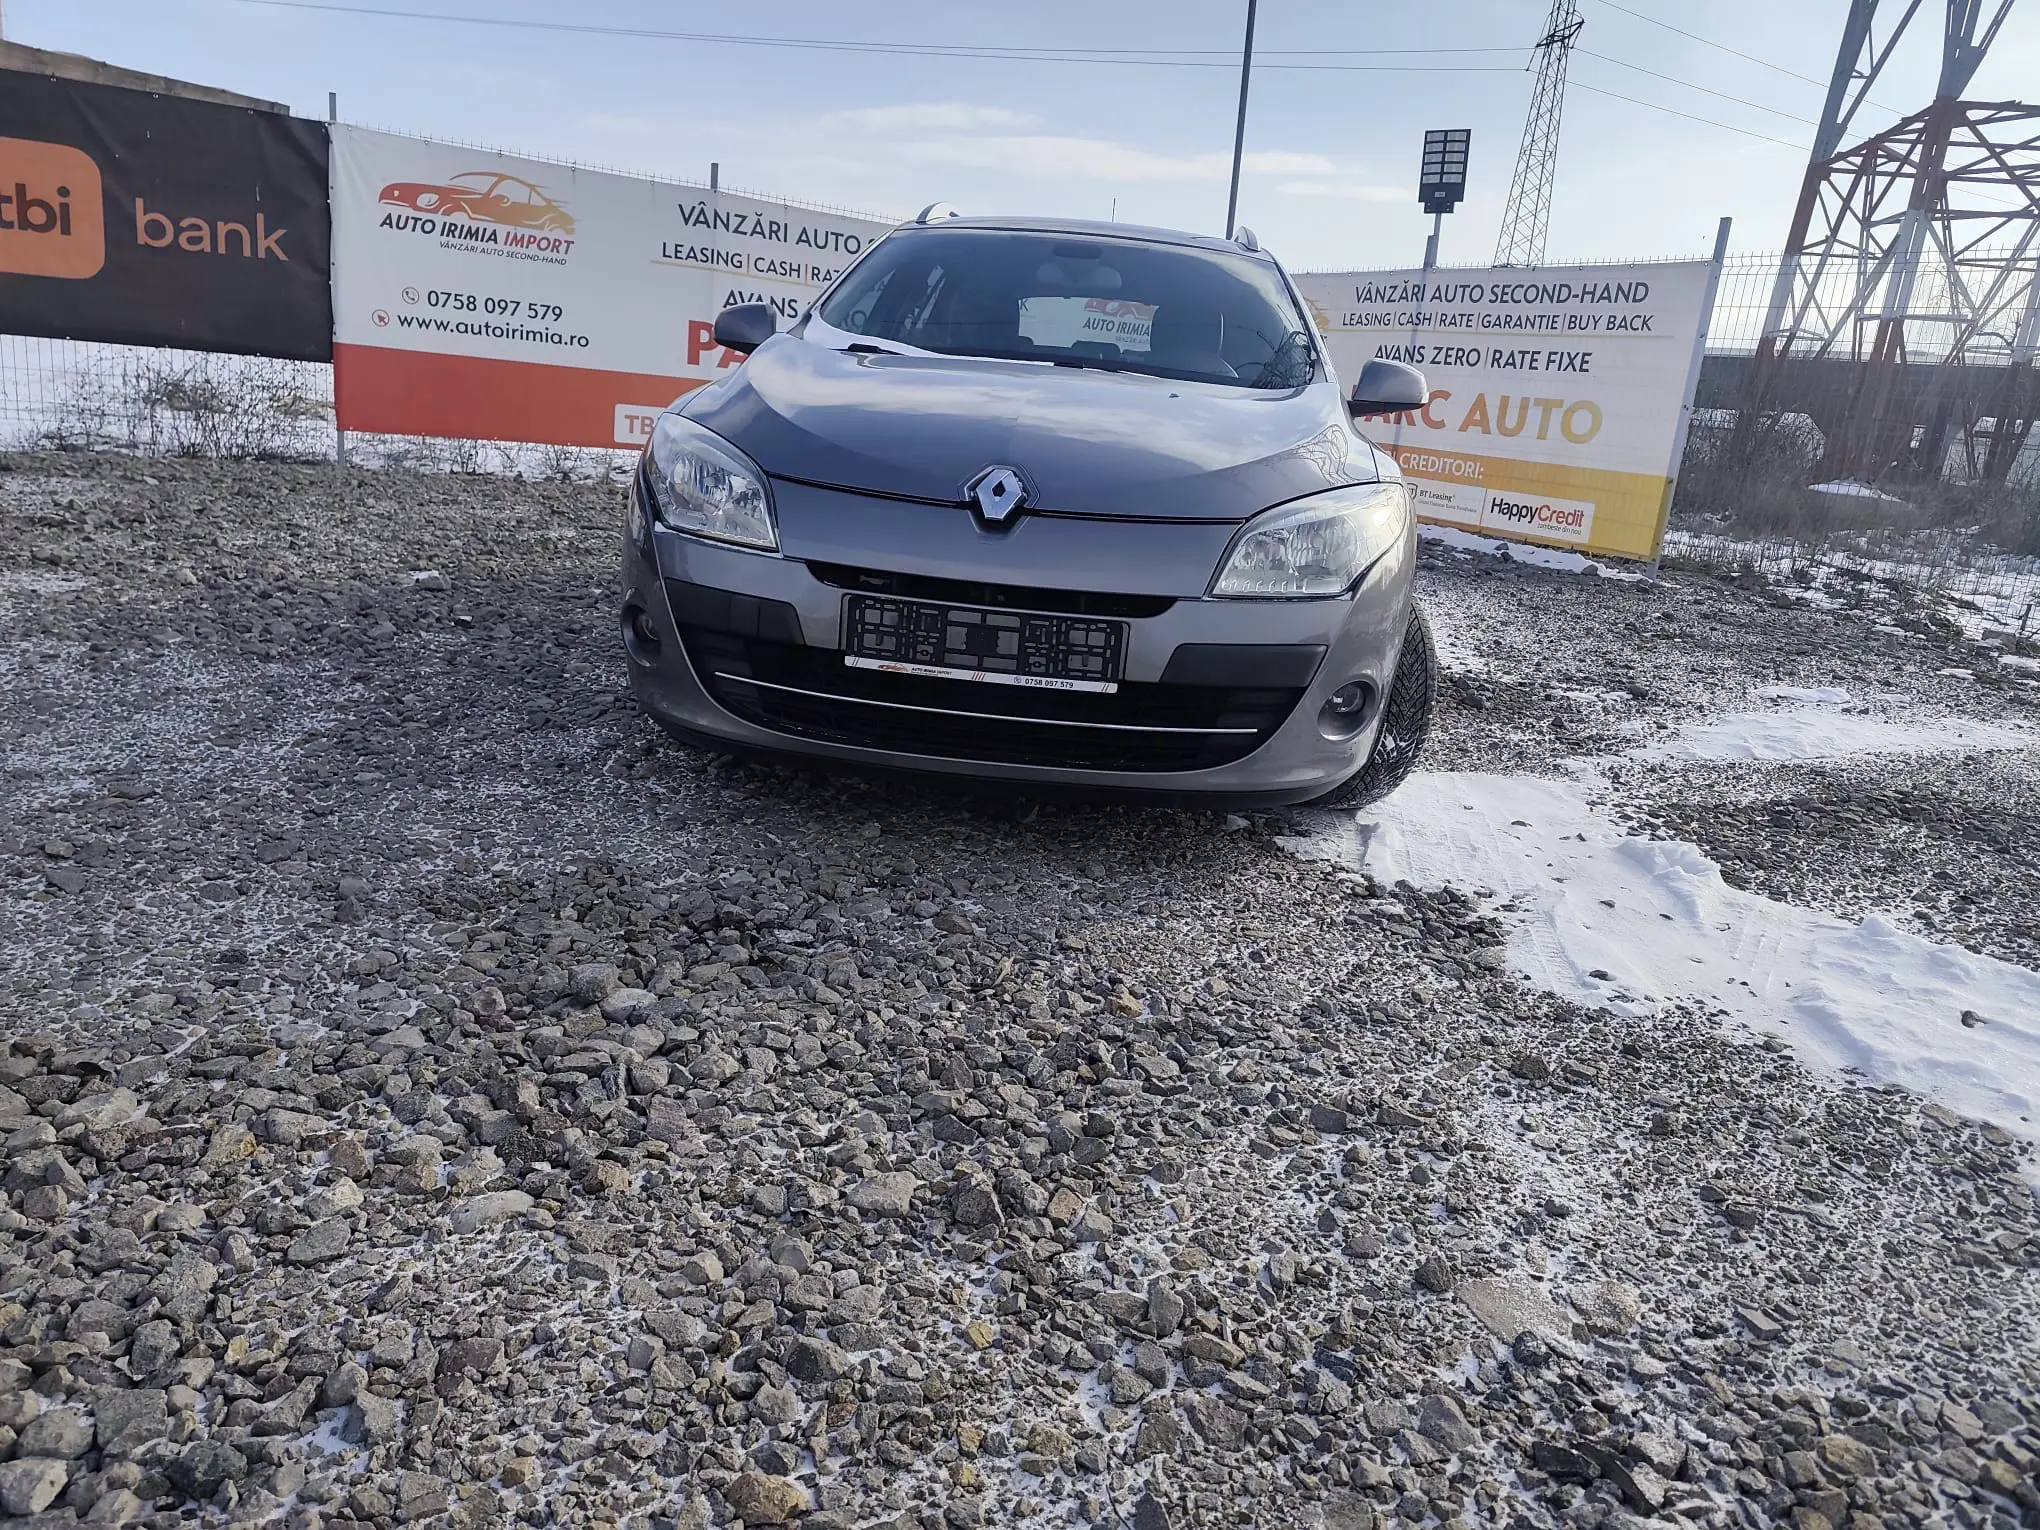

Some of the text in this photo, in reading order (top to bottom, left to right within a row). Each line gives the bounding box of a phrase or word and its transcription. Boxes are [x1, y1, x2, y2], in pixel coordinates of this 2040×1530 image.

[135, 197, 288, 261] bank
[380, 212, 575, 255] AUTO IRIMIA IMPORT
[678, 201, 861, 255] VÂNZĂRI AUTO
[480, 247, 504, 256] AUTO
[505, 250, 567, 266] SECOND-HAND
[662, 242, 743, 269] LEASING
[754, 257, 801, 279] CASH
[427, 290, 563, 322] 0758 097 579
[1355, 280, 1650, 305] VÂNZĂRI AUTO SECOND-HAND
[397, 314, 589, 348] www.autoirimia.ro
[1082, 317, 1150, 337] AUTO IRIMIA
[1342, 312, 1391, 327] LEASING
[1398, 312, 1432, 327] CASH
[1439, 312, 1474, 328] RATE
[1568, 314, 1602, 331] BUY
[1606, 314, 1654, 331] BACK
[1374, 345, 1593, 373] AVANS ZERO RATE FIXE
[1458, 392, 1603, 445] AUTO
[1400, 453, 1484, 479] CREDITORI:
[1490, 497, 1585, 528] HappyCredit
[1024, 677, 1074, 689] 0758 097 579
